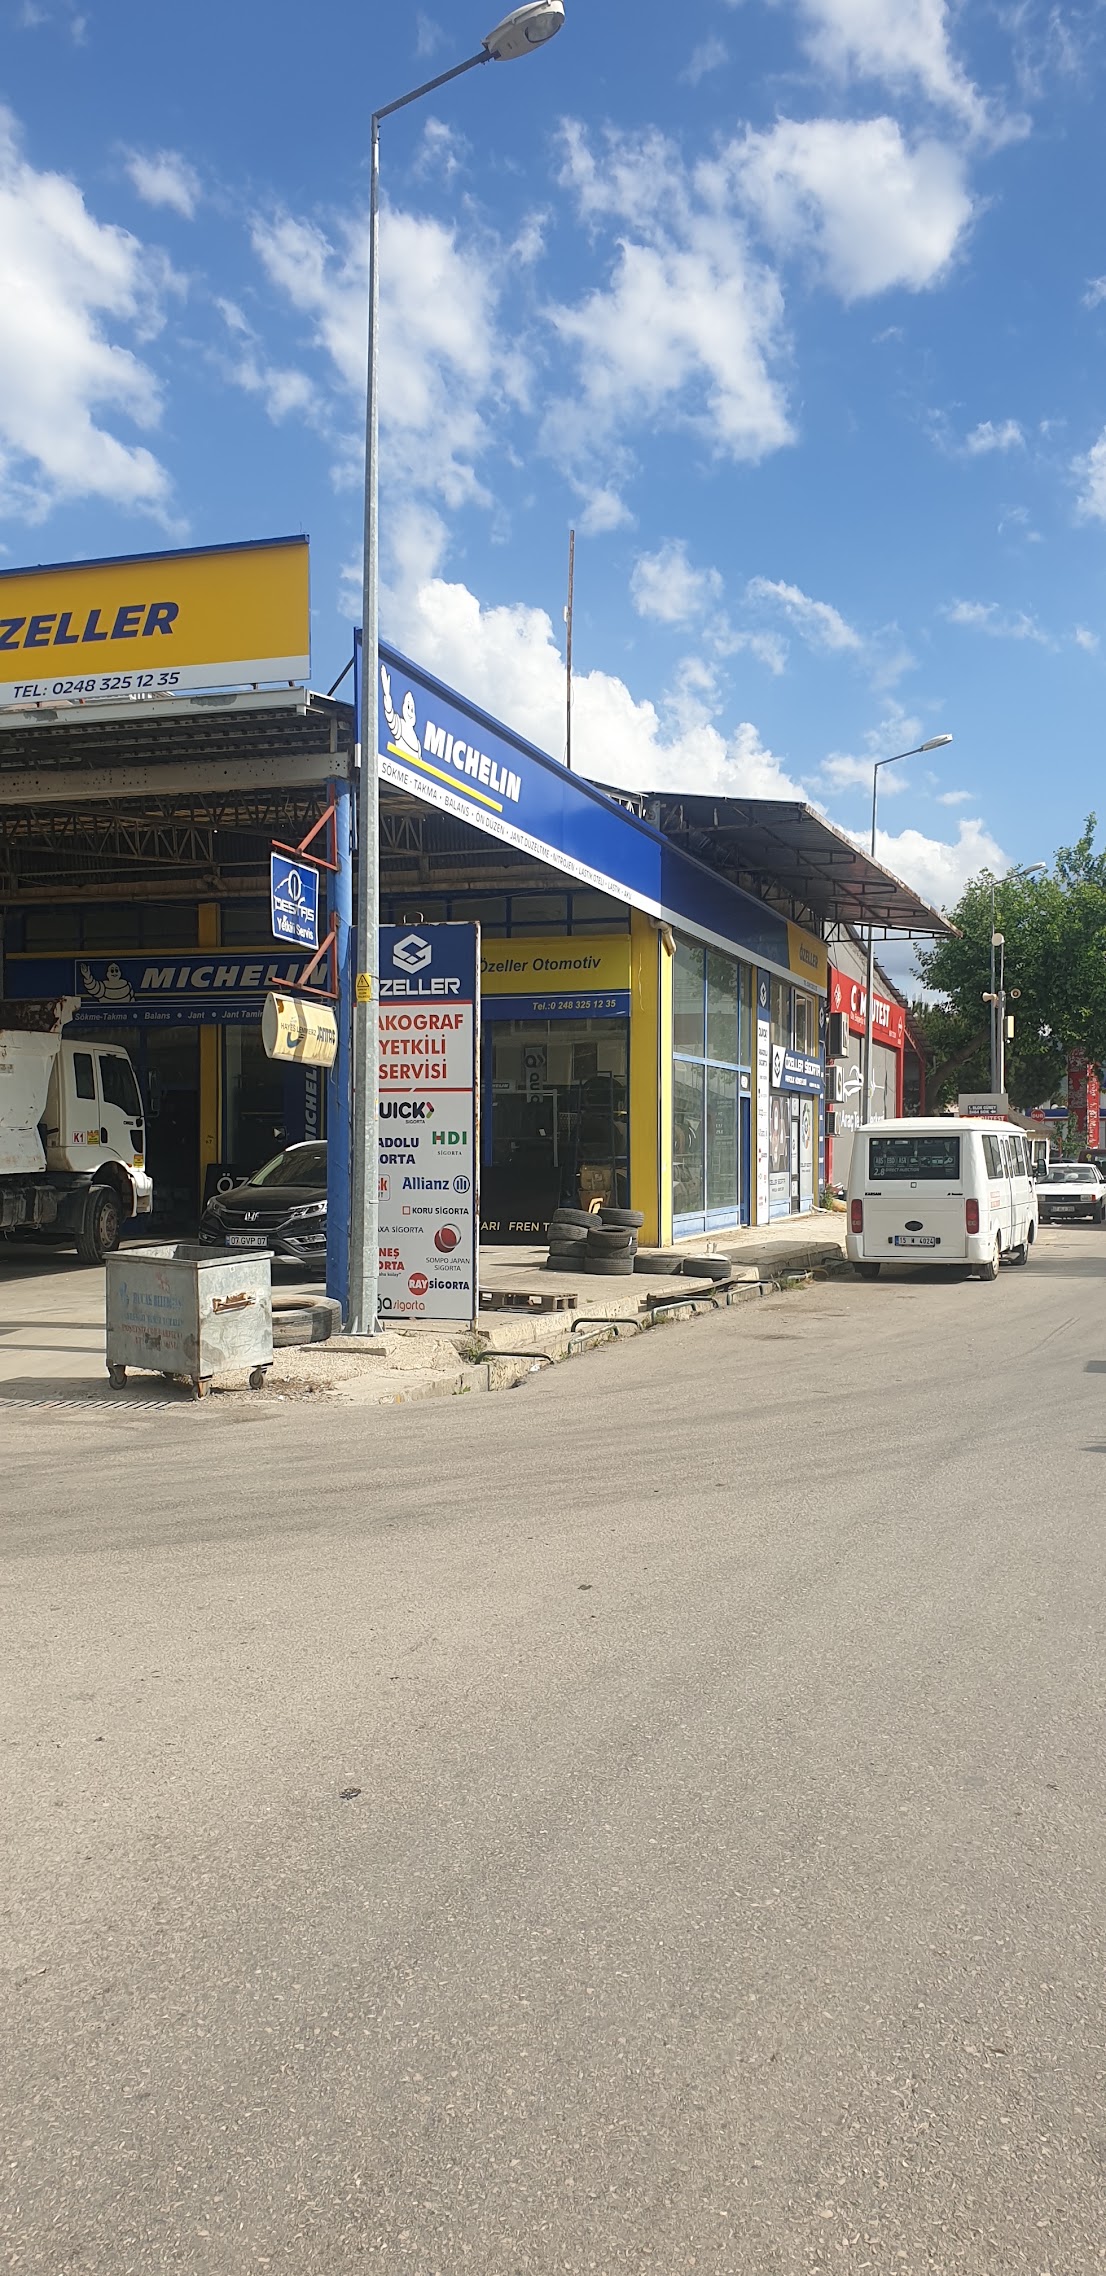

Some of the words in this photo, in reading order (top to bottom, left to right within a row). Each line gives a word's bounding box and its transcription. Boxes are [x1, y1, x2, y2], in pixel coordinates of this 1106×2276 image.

[0, 602, 179, 650] ZELLER
[13, 684, 48, 699] TEL:
[53, 679, 96, 695] 0248
[100, 676, 133, 691] 325
[137, 674, 154, 688] 12
[157, 671, 181, 686] 35
[423, 720, 522, 803] MICHELIN
[381, 762, 409, 786] SÖKME
[413, 779, 438, 799] TAKMA
[444, 795, 470, 817] BALANS
[296, 924, 314, 940] Servis
[532, 956, 602, 971] Otomotiv
[140, 963, 328, 989] MICHELIN
[379, 977, 461, 996] ZELLER
[558, 1001, 573, 1010] 248
[575, 1001, 591, 1009] 325
[593, 1000, 604, 1008] 12
[605, 1000, 617, 1008] 35
[75, 1012, 128, 1021] Sökme-Takma
[144, 1011, 171, 1020] Balans
[187, 1011, 205, 1020] Jant
[221, 1010, 240, 1019] Jant
[379, 1033, 446, 1055] YETKİLİ
[378, 1058, 447, 1080] SERVİSİ
[73, 1132, 84, 1143] K1
[432, 1131, 467, 1145] HDI
[873, 1167, 885, 1176] 2.8
[402, 1177, 450, 1190] Allianz
[435, 1206, 469, 1215] SİGORTA
[391, 1225, 424, 1233] SİGORTA
[508, 1221, 540, 1231] FREN
[230, 1237, 239, 1245] 07
[240, 1237, 256, 1245] GVP
[257, 1236, 266, 1245] 07
[408, 1279, 428, 1289] RAY
[428, 1278, 470, 1290] SİGORTA
